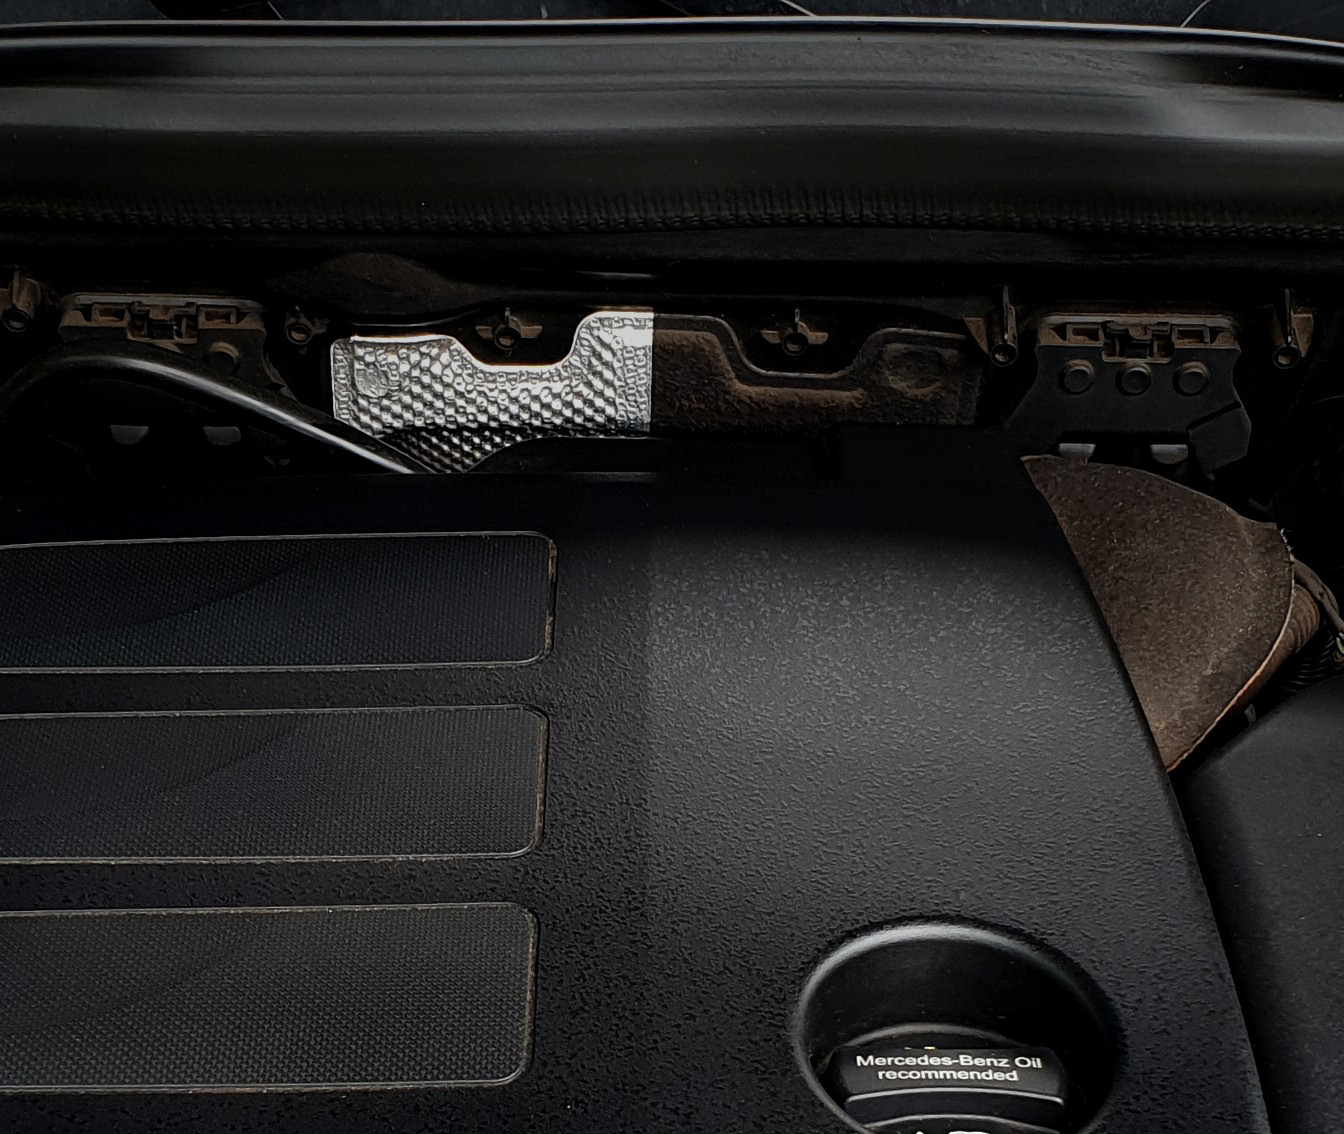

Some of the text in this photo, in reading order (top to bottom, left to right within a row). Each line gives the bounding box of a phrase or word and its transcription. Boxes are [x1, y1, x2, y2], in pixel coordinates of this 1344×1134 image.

[856, 1055, 1042, 1069] Mercedes-Benz Oil
[877, 1069, 1019, 1081] recommended
